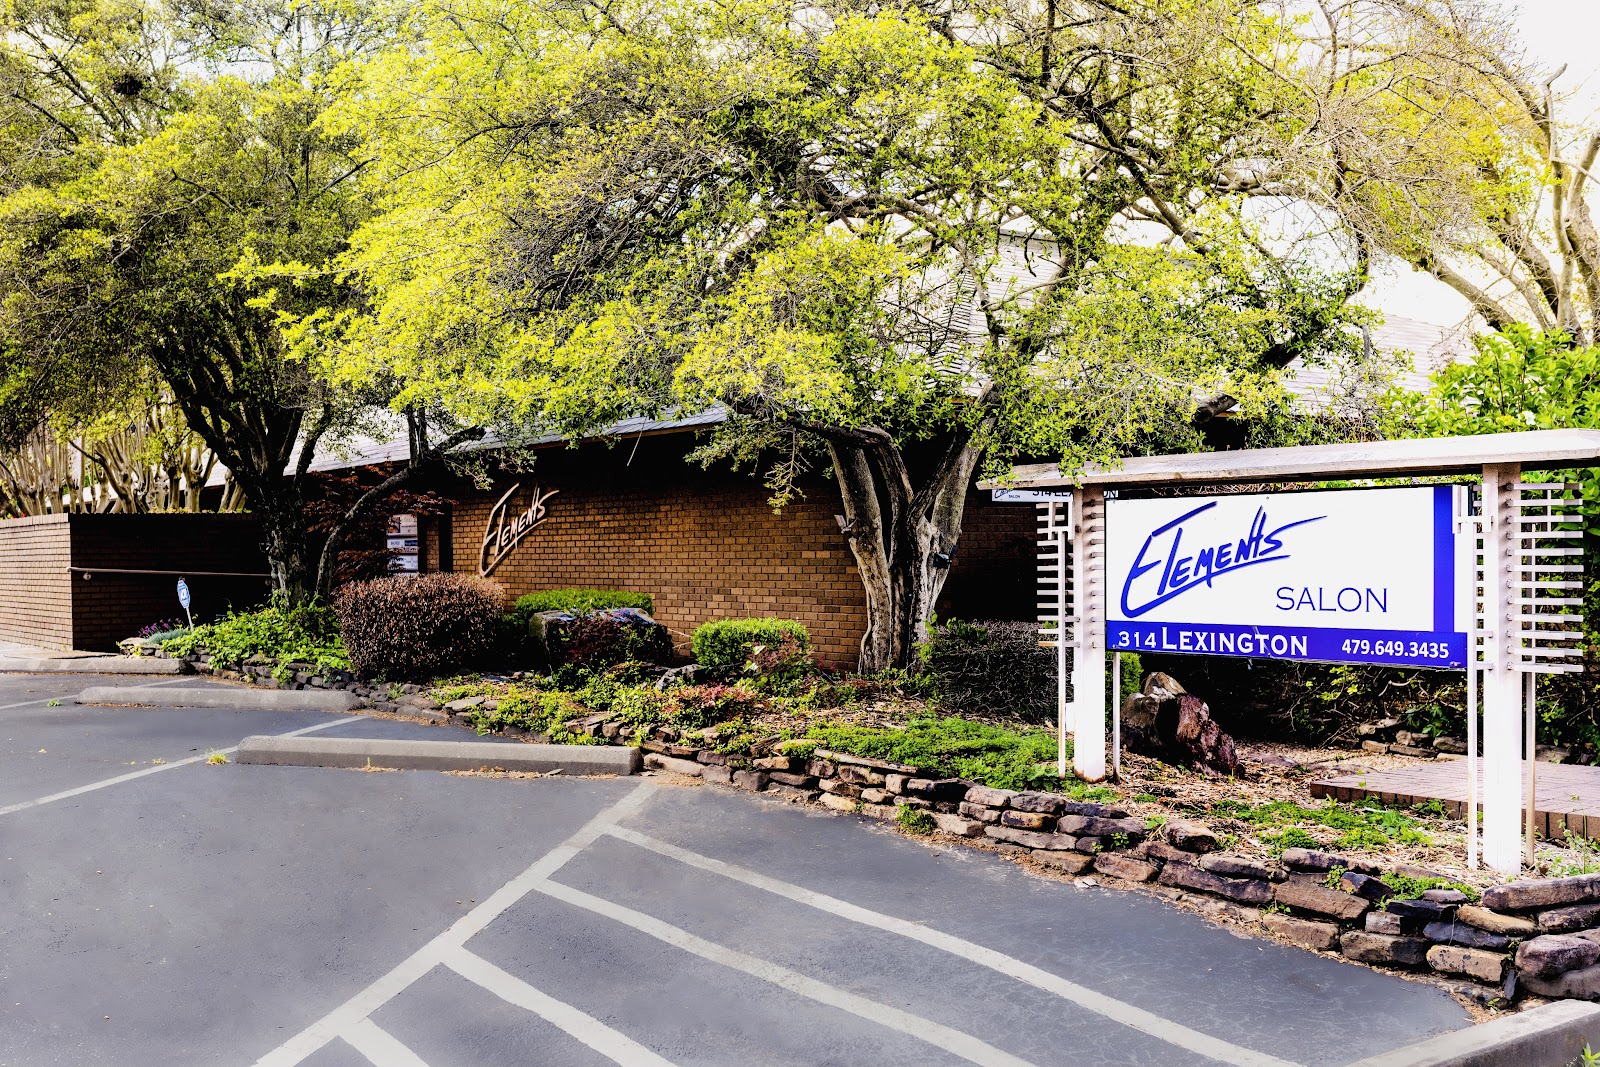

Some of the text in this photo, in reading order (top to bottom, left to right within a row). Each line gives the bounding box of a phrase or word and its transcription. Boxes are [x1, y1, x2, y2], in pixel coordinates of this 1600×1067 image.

[1275, 586, 1388, 613] SALON
[1118, 626, 1450, 659] 314 LEXINGTON 479.649.3435
